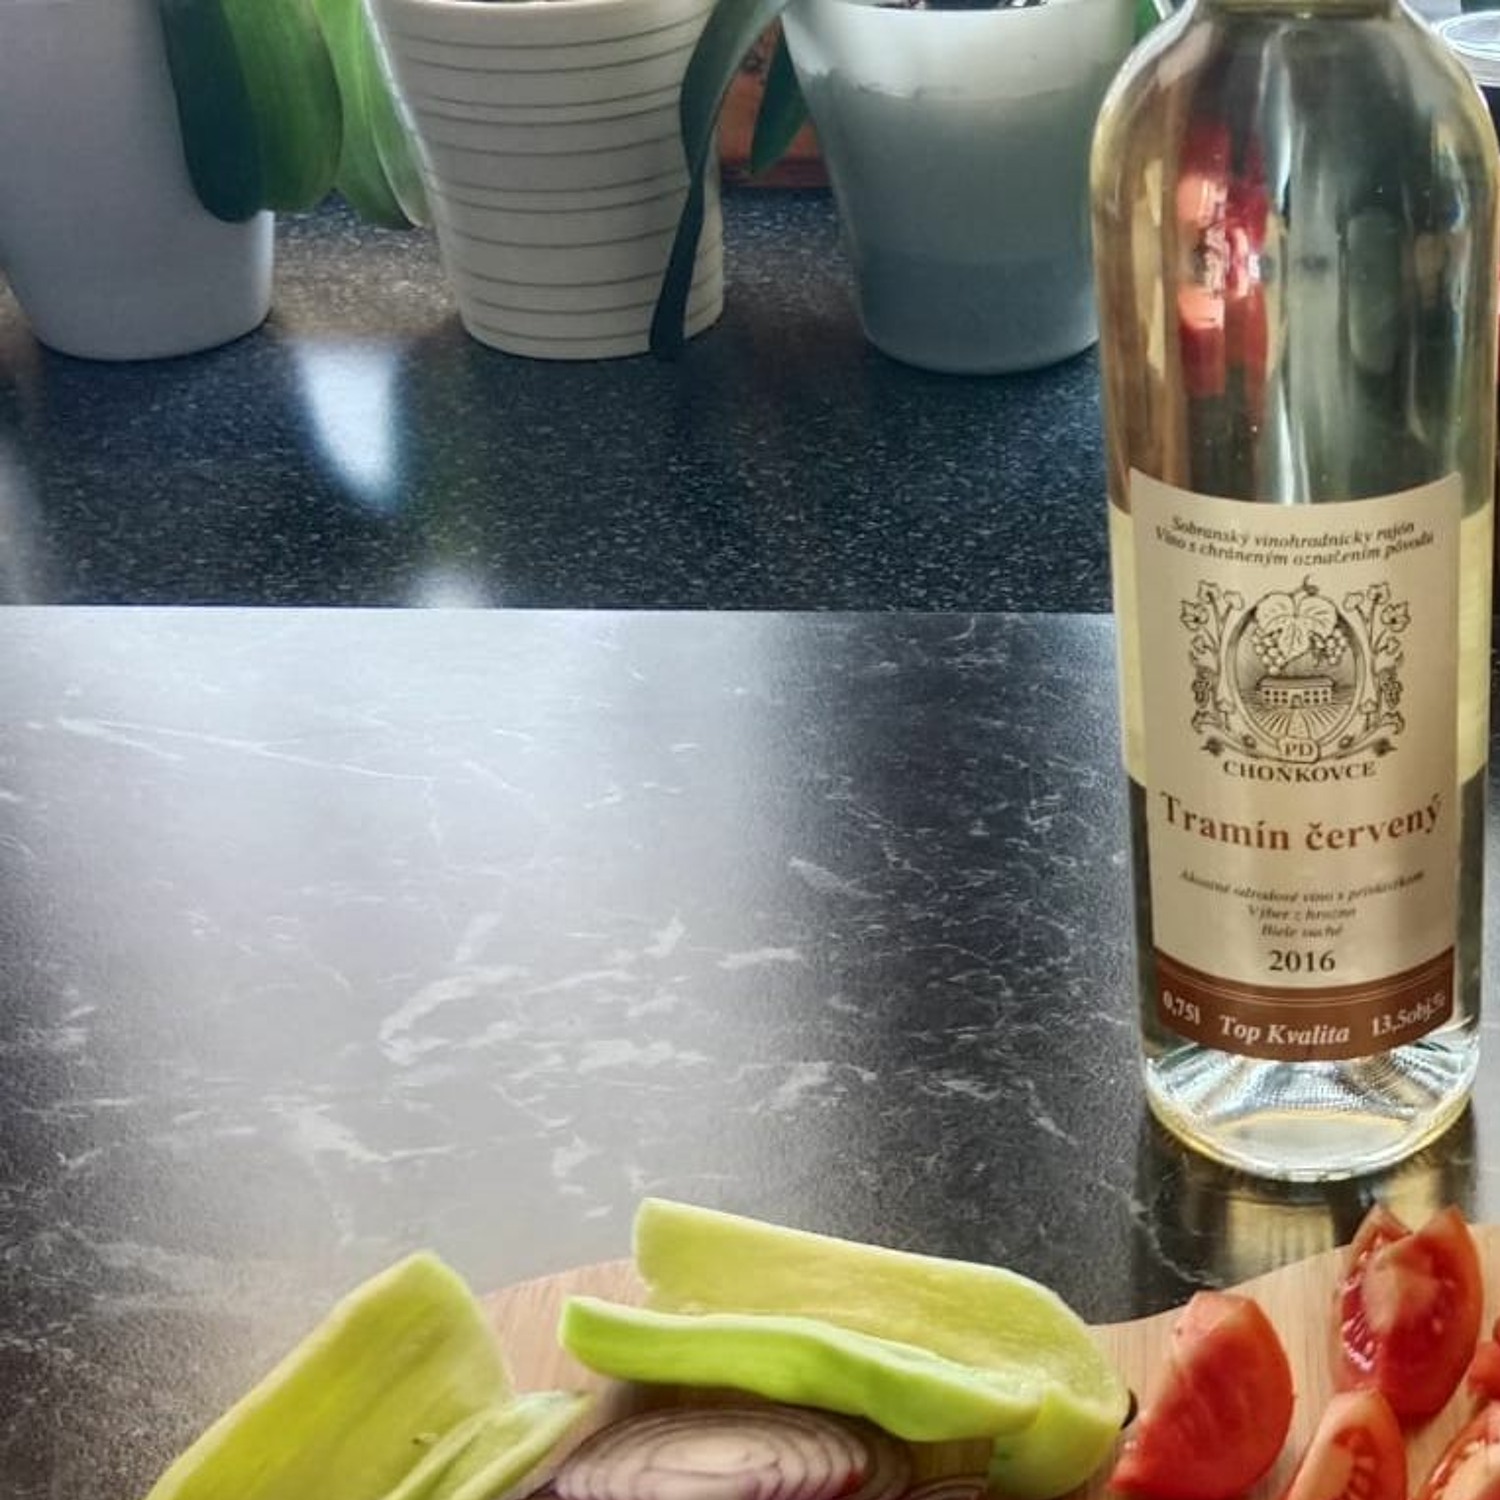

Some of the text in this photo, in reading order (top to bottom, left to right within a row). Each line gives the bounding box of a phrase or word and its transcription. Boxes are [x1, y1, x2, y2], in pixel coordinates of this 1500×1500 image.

[1285, 743, 1313, 757] PD
[1159, 791, 1442, 851] Tramín červený
[1268, 950, 1335, 973] 2016
[1219, 1014, 1261, 1045] Top
[1267, 1023, 1350, 1045] Kvalita
